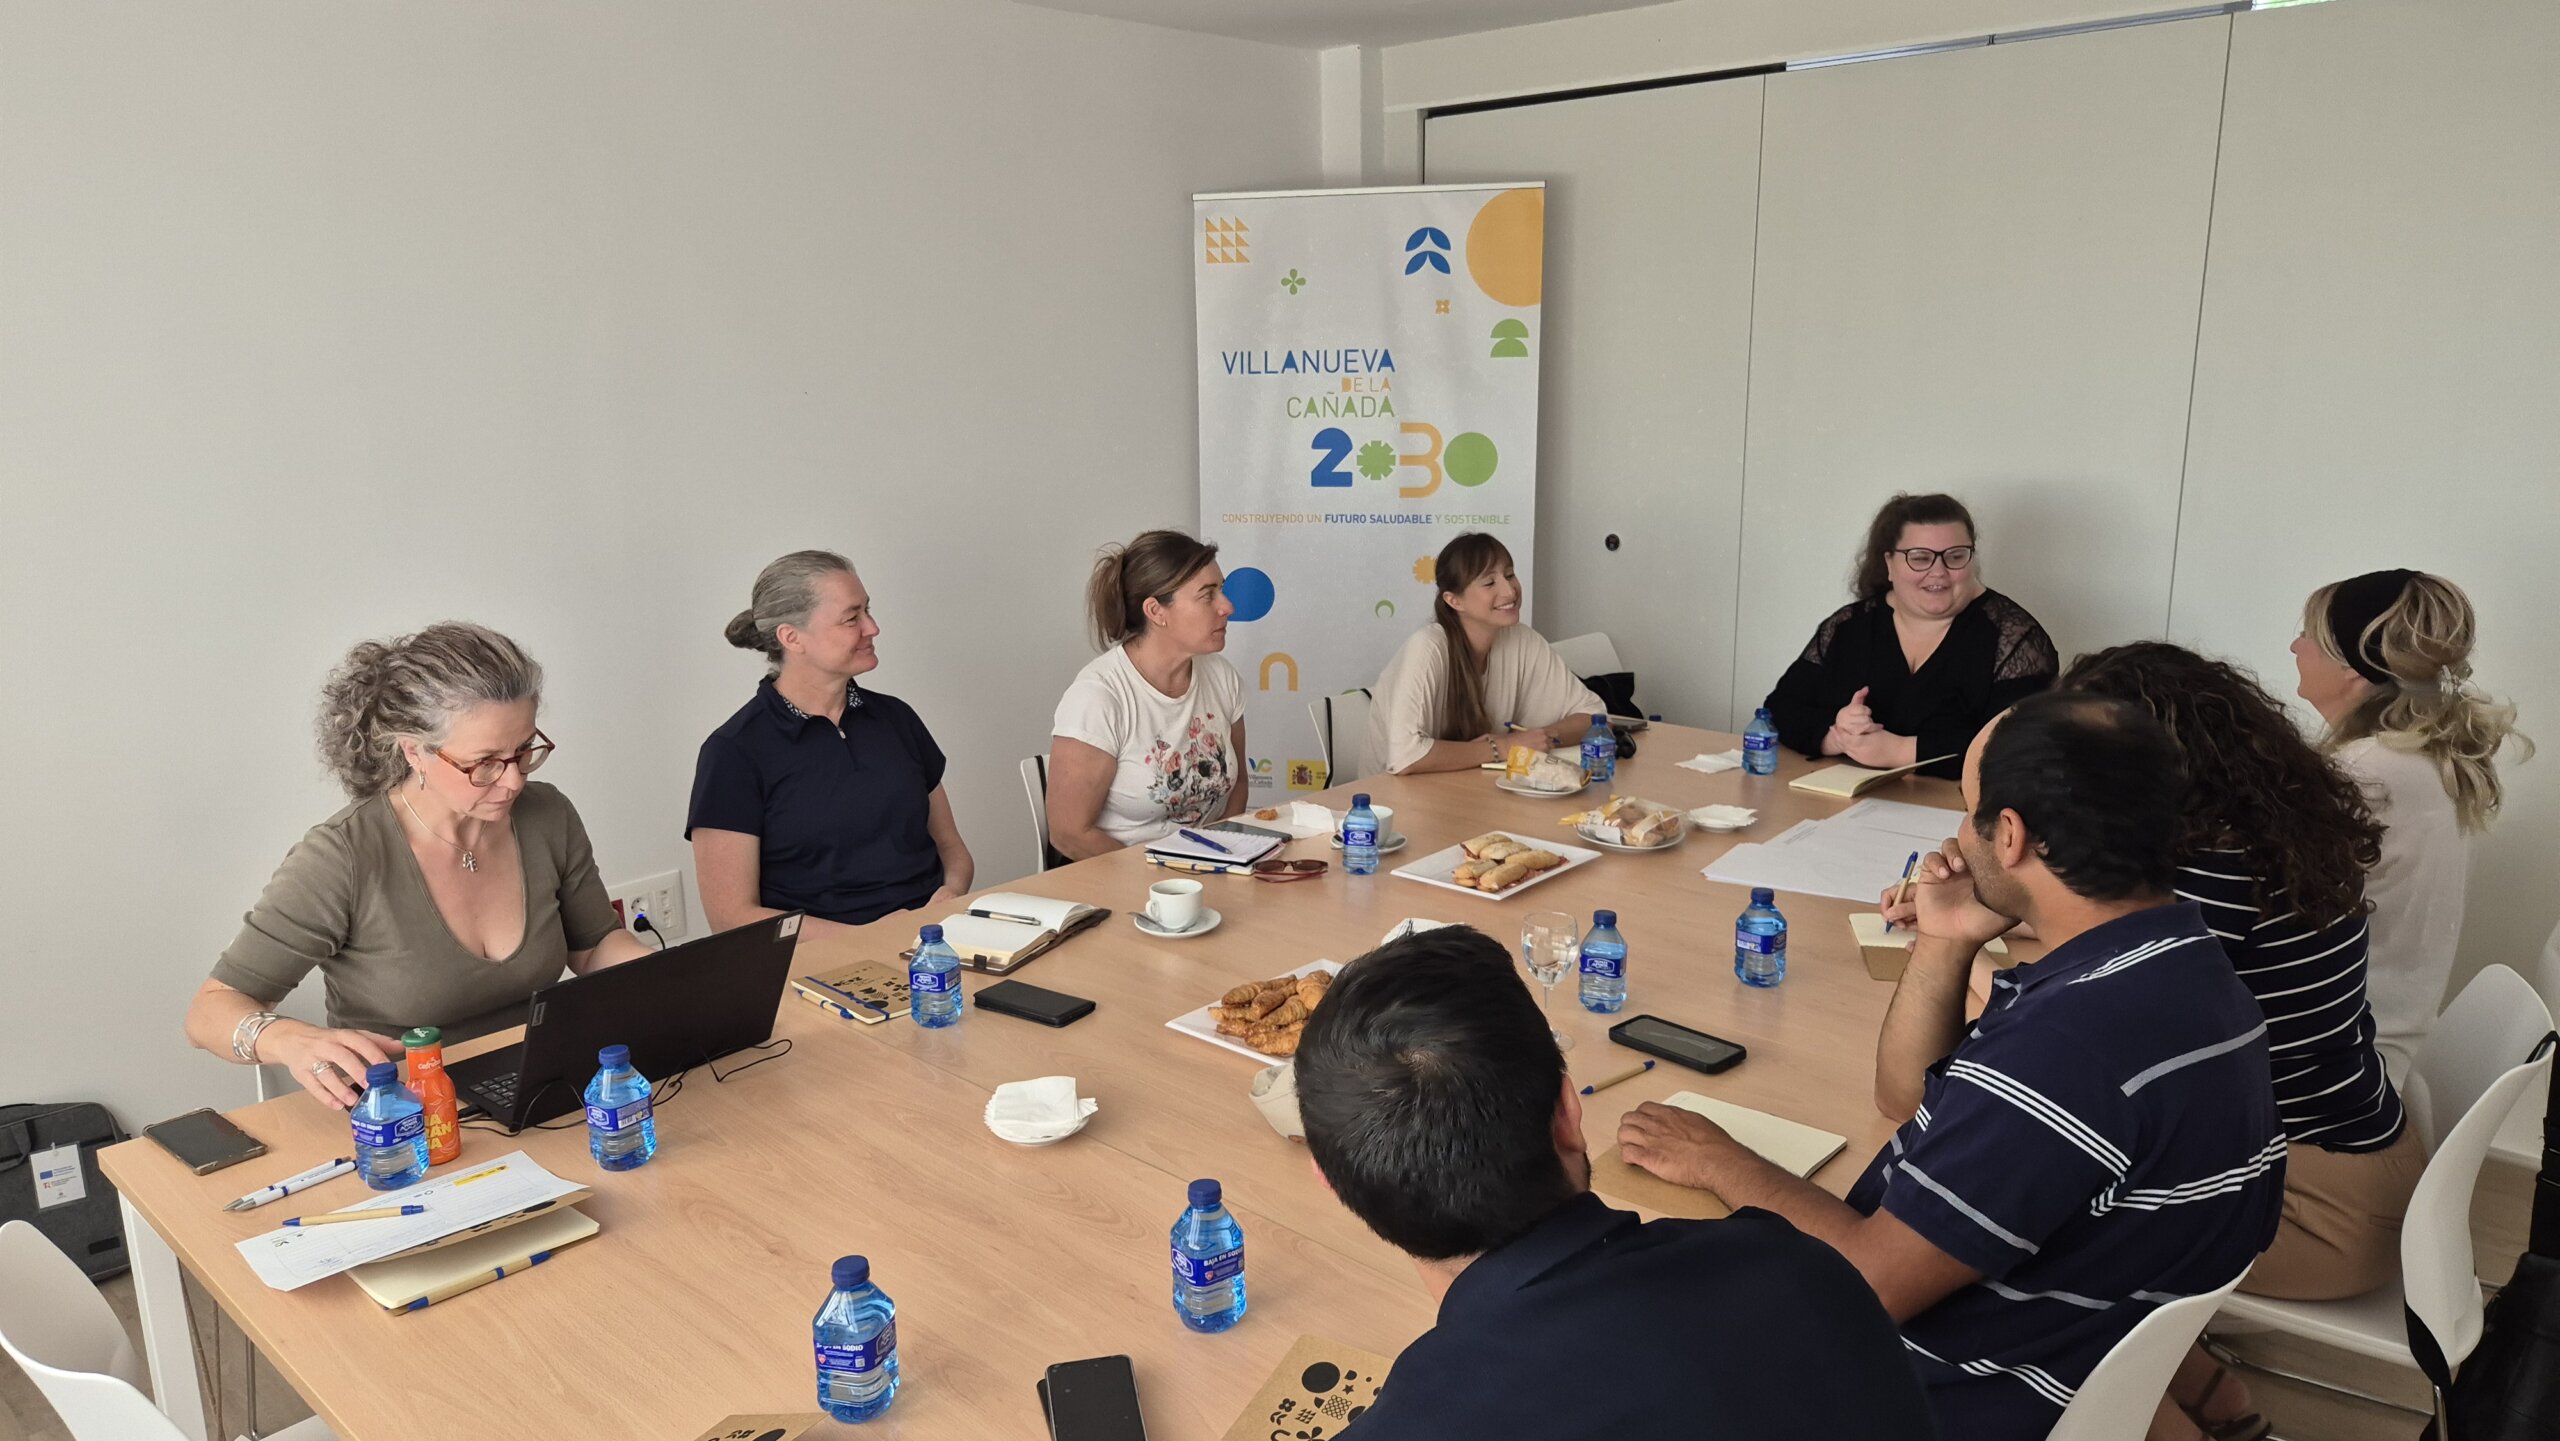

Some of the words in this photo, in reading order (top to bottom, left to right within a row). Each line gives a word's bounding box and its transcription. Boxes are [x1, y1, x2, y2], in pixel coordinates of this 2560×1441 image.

[1222, 349, 1396, 375] VILLANUEVA
[1341, 377, 1363, 393] DE
[1369, 377, 1392, 393] LA
[1286, 391, 1395, 419] CAÑADA
[1222, 513, 1304, 524] CONSTRUYENDO
[1307, 513, 1322, 524] UN
[1325, 514, 1367, 524] FUTURO
[1369, 514, 1433, 524] SALUDABLE
[1434, 514, 1442, 524] Y
[1444, 514, 1511, 525] SOSTENIBLE
